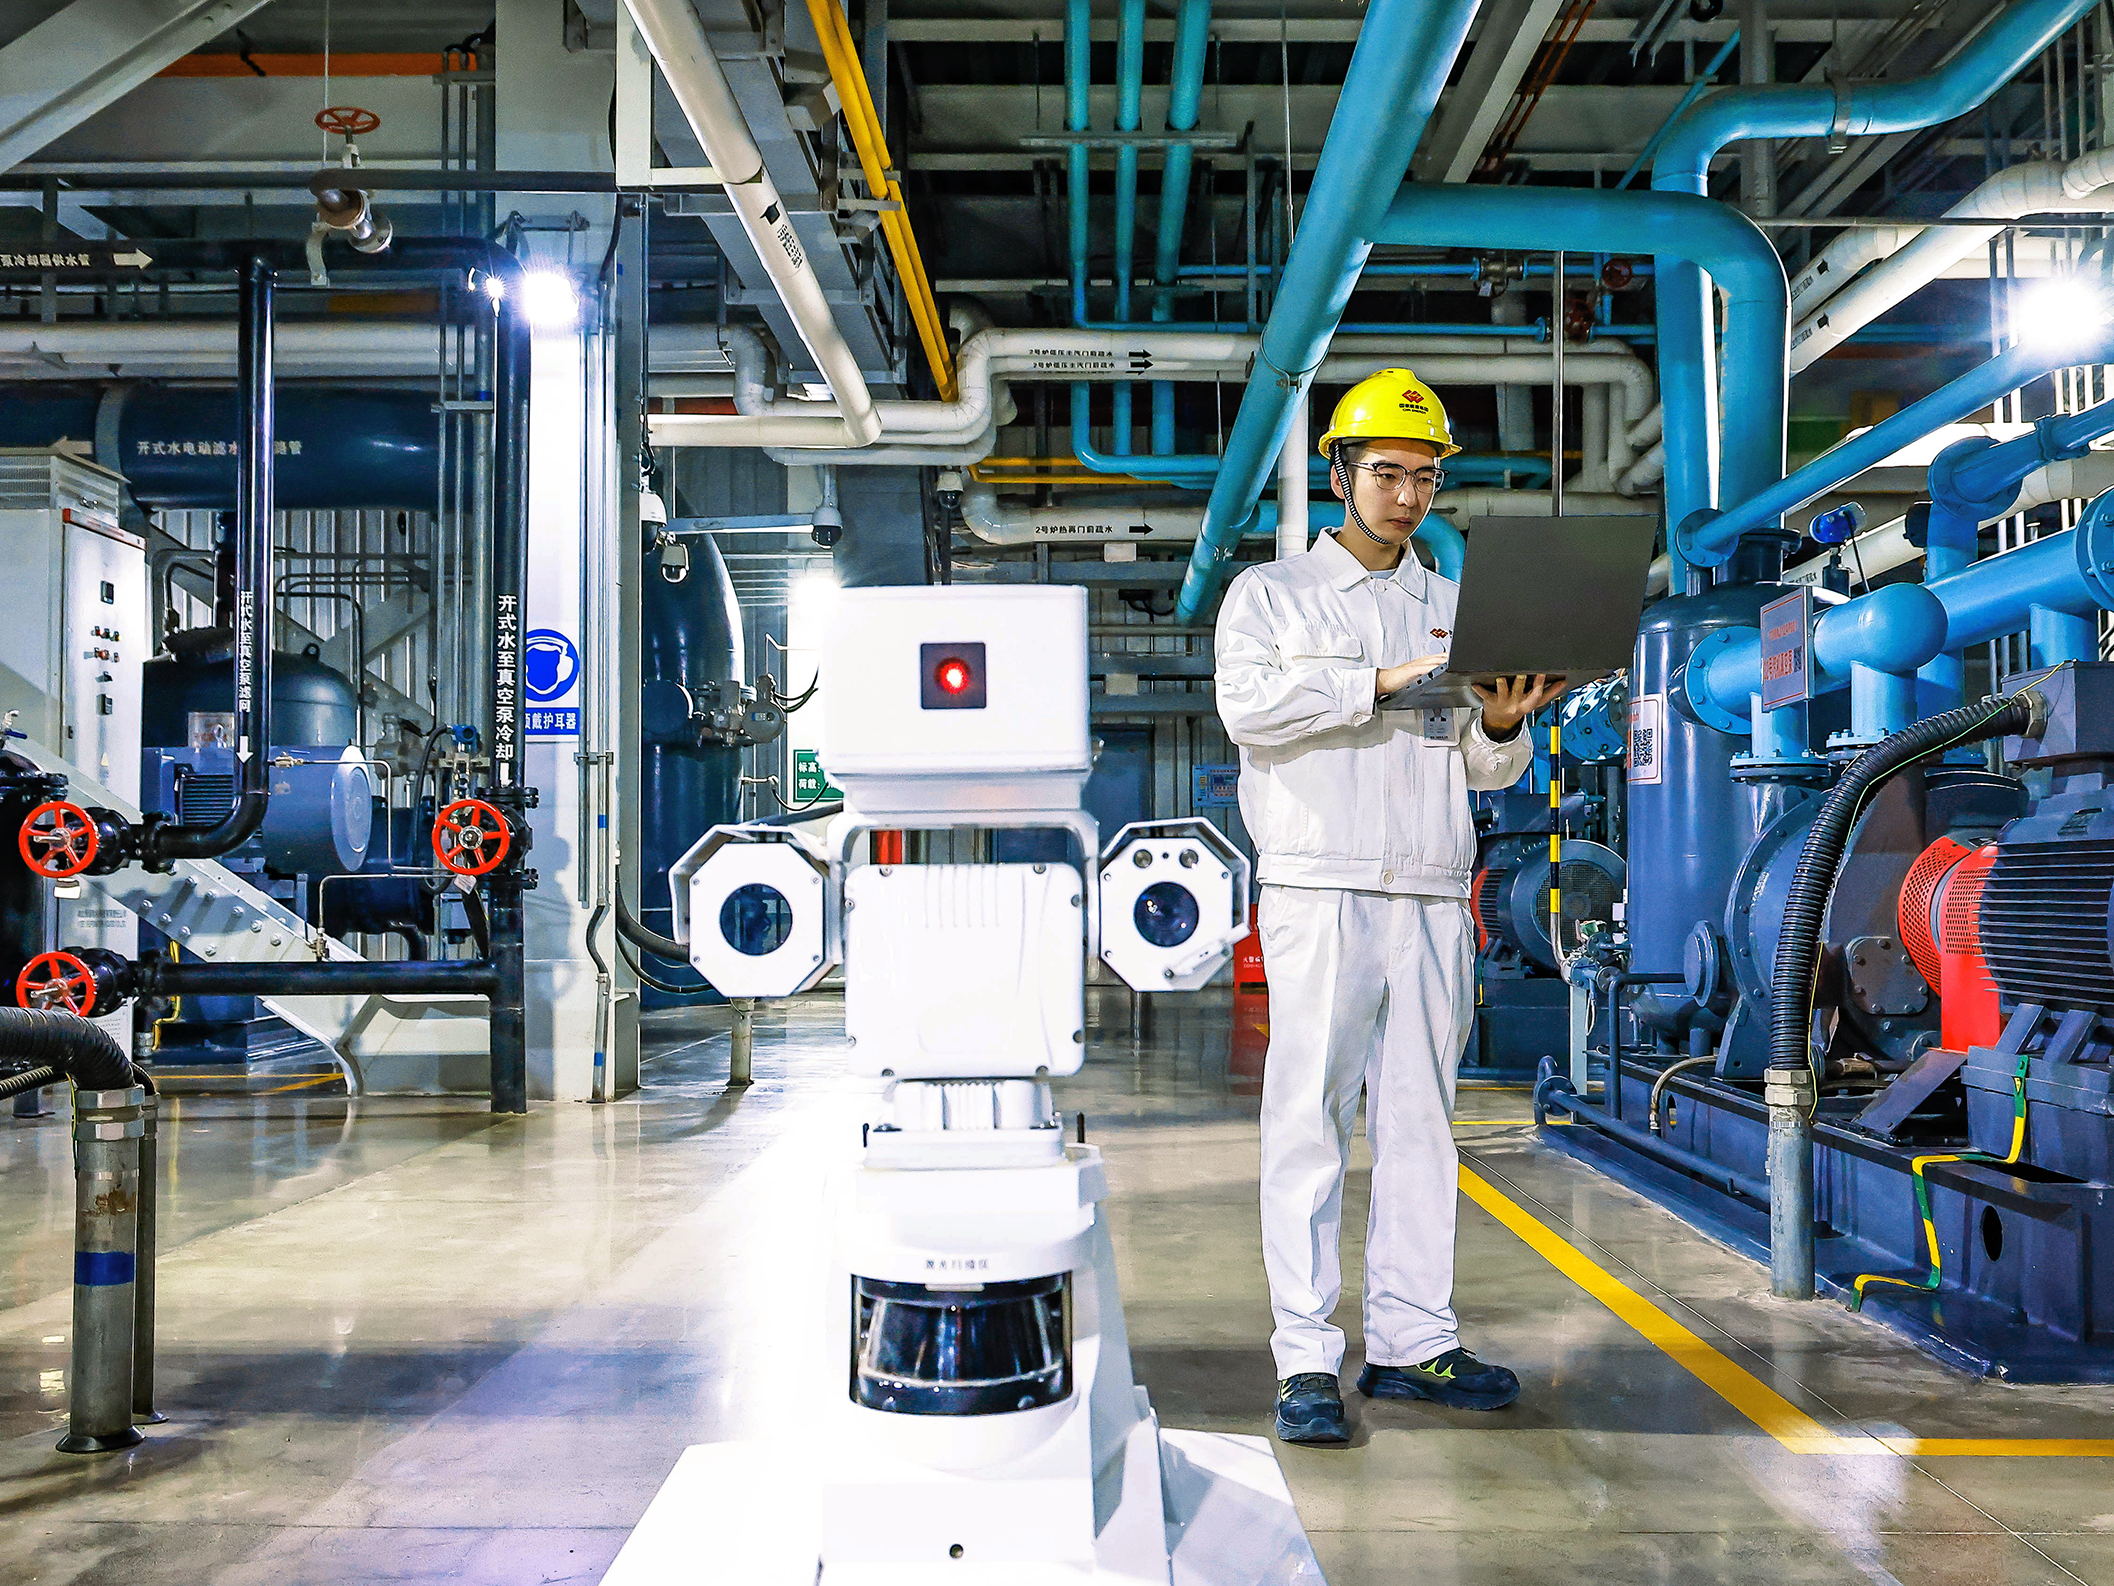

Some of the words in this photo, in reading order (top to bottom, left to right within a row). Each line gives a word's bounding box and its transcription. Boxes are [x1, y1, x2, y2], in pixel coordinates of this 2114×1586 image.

[495, 594, 517, 761] 开式水至真空泵冷却
